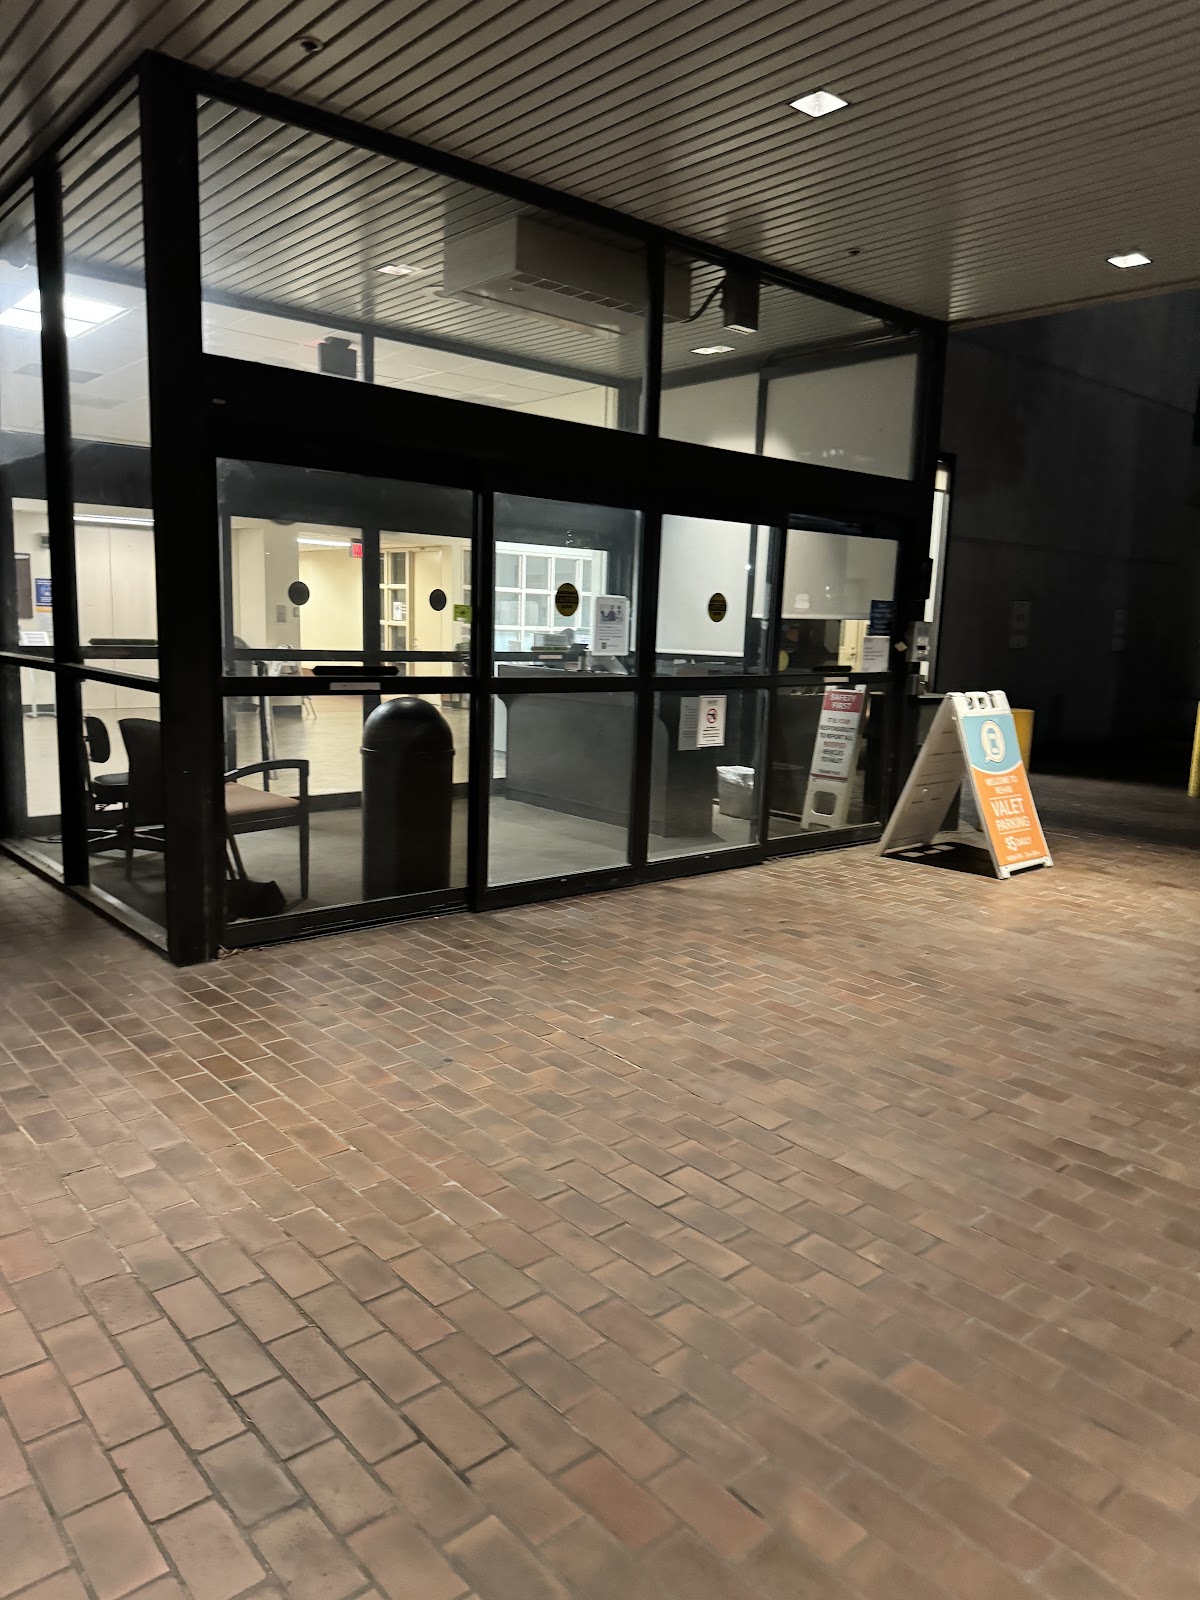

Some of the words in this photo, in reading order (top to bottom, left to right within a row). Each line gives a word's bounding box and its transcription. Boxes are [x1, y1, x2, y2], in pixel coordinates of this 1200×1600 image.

[830, 694, 856, 702] SAFETY
[985, 776, 1010, 787] WELCOME
[990, 798, 1025, 817] VALET
[995, 815, 1031, 832] PARKING
